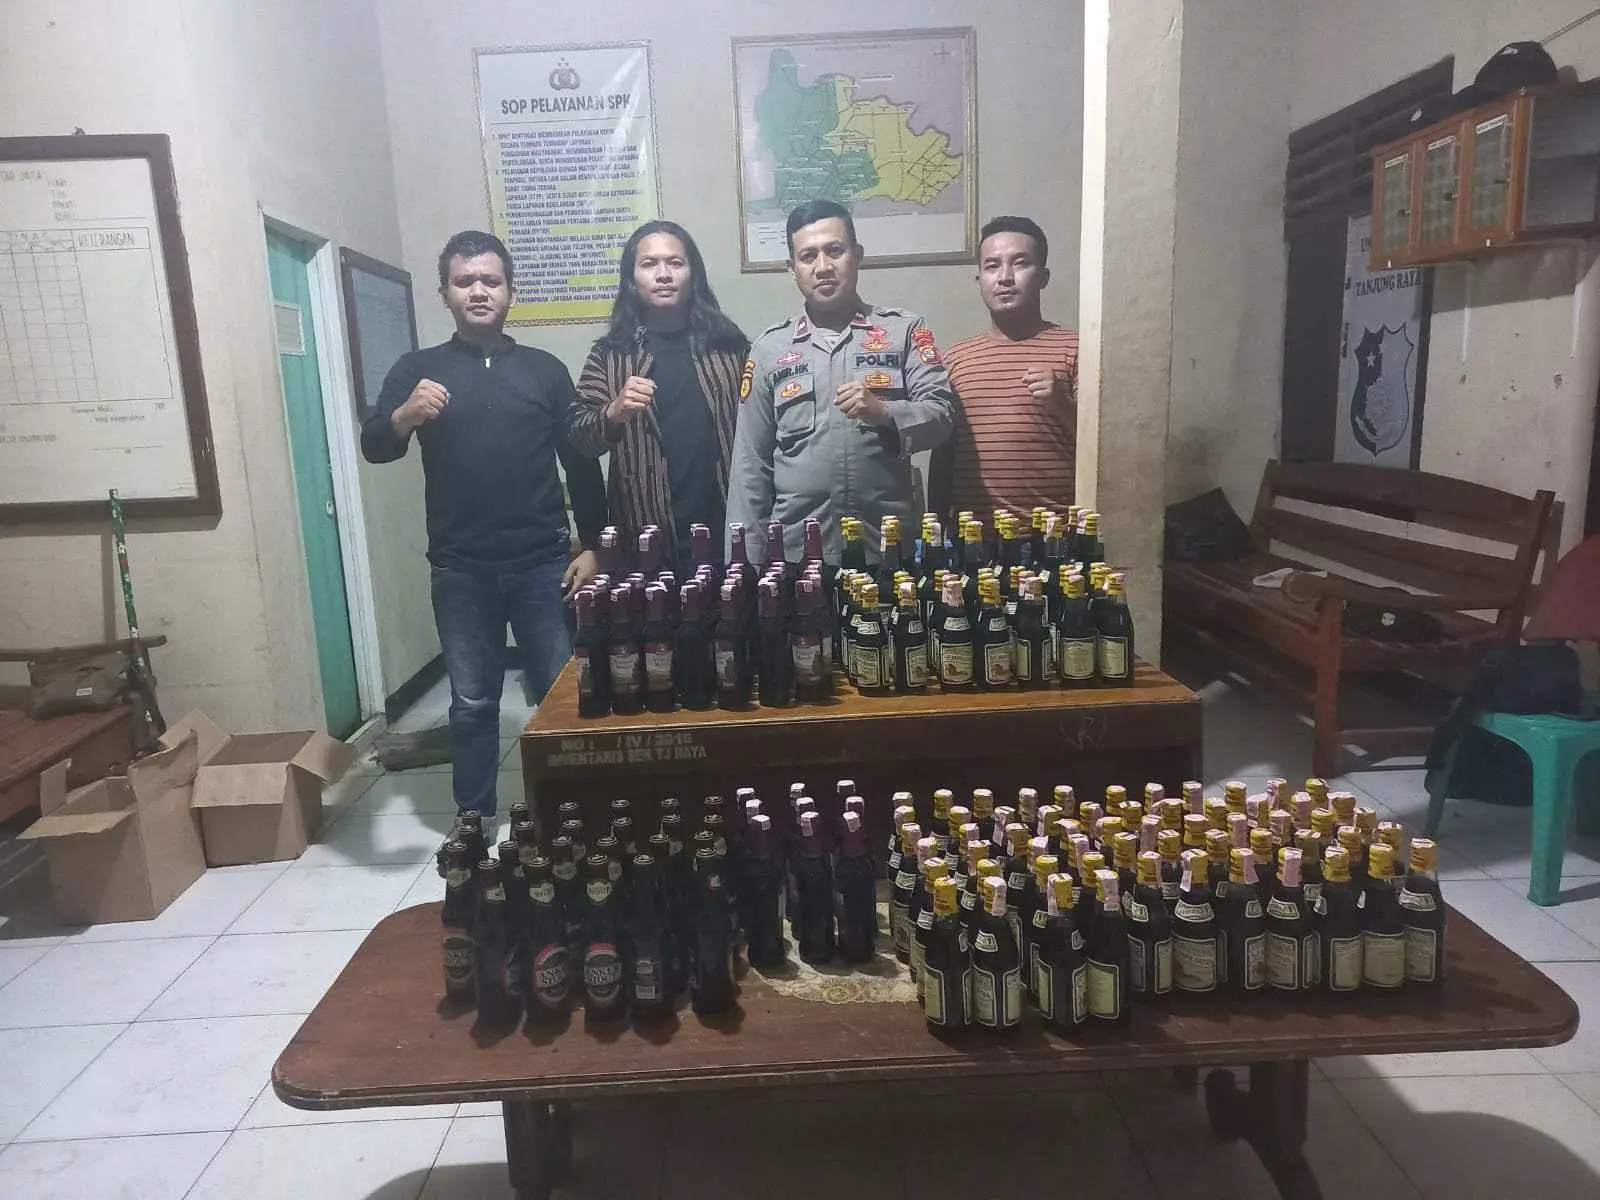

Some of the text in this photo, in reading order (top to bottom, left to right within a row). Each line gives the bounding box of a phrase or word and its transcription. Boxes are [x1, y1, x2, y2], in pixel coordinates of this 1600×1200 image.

[501, 100, 528, 114] SOP
[530, 96, 604, 113] PELAYANAN
[1356, 270, 1422, 296] TANJUNG RAYA
[856, 354, 898, 367] POLRI
